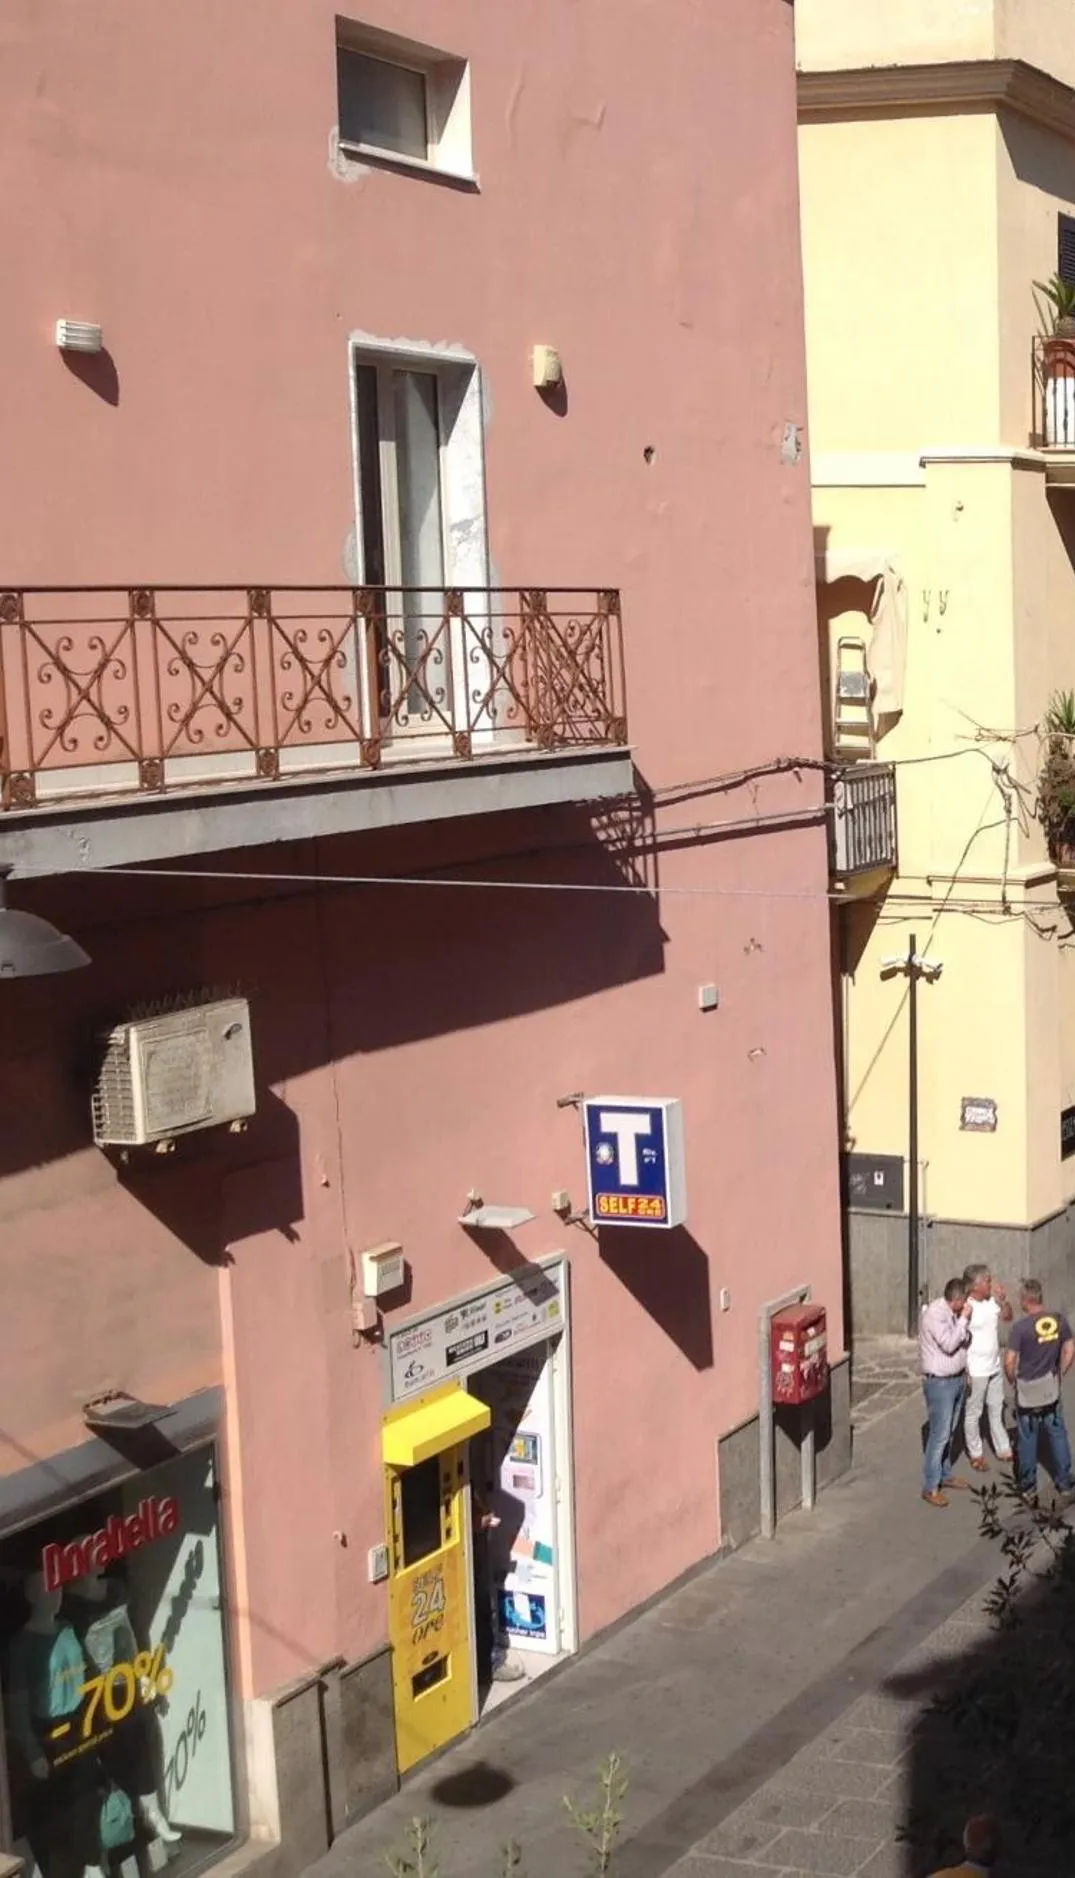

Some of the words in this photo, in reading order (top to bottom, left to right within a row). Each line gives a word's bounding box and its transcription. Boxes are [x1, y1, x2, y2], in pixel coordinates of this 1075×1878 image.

[600, 1112, 651, 1186] T
[600, 1196, 637, 1215] SELF
[42, 1496, 178, 1592] Dorabella
[411, 1578, 446, 1628] 24
